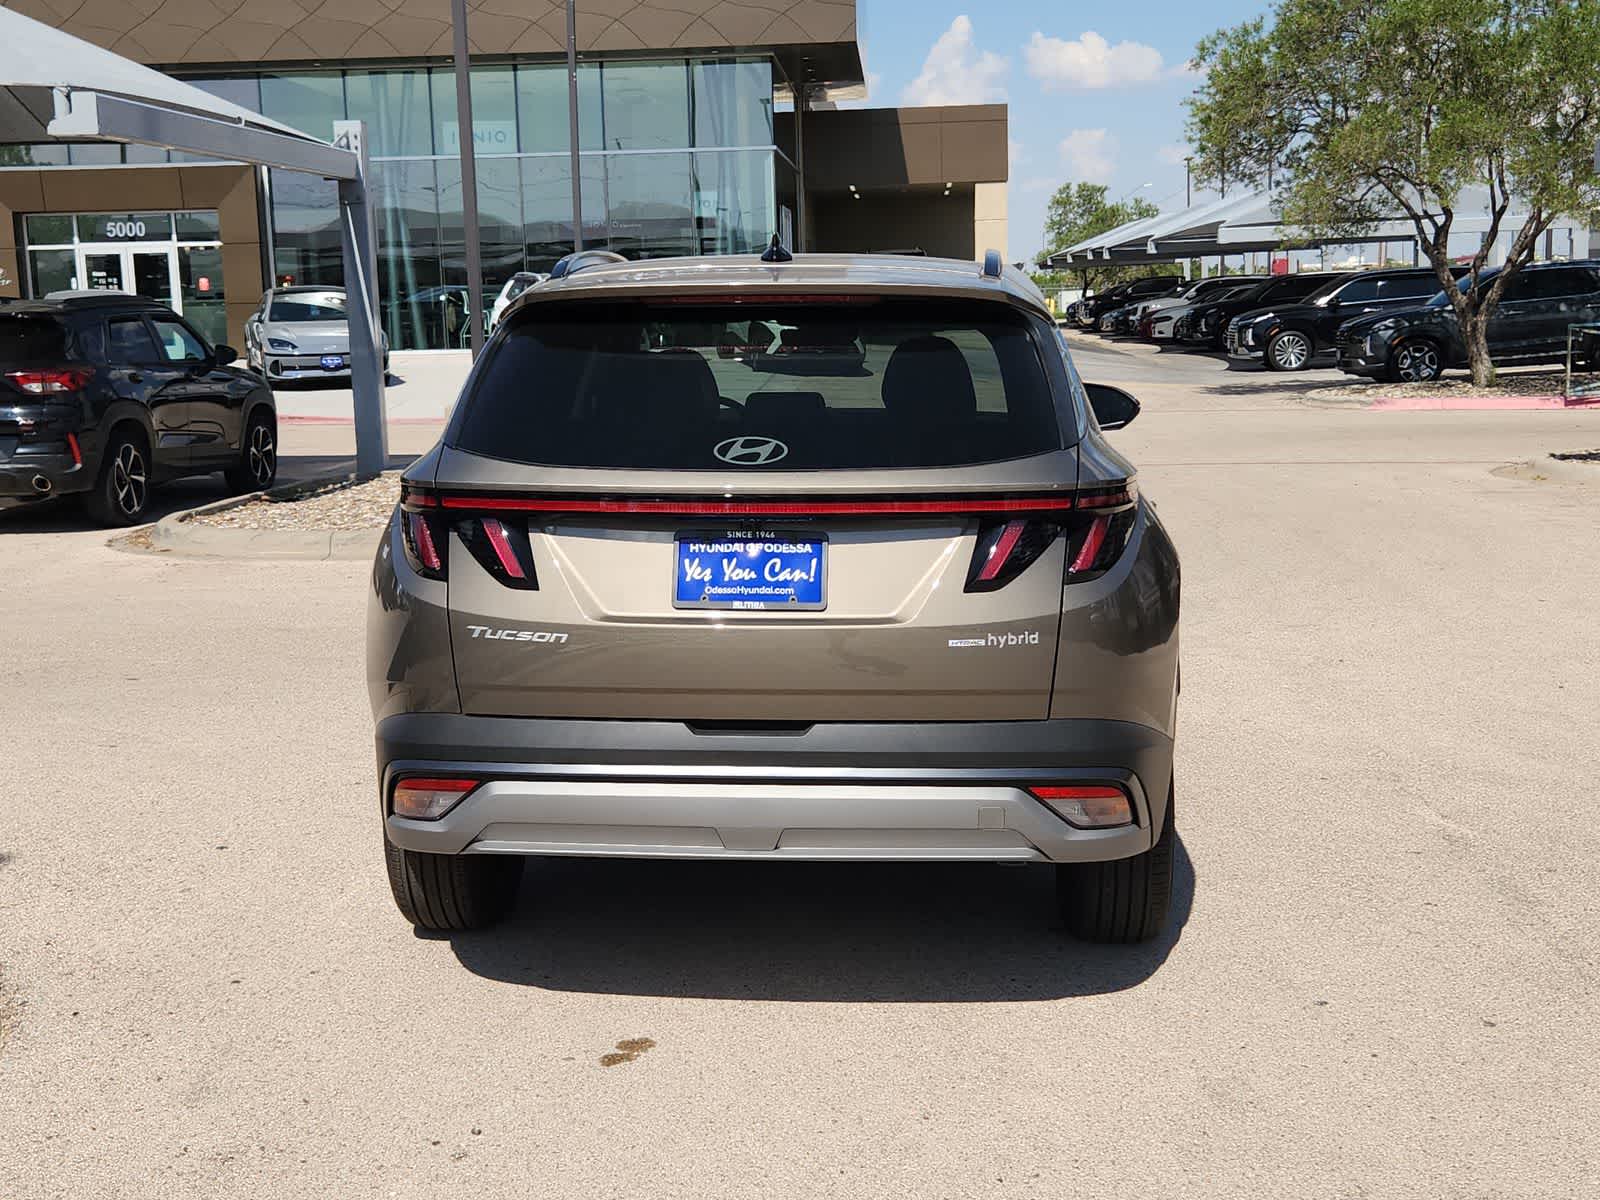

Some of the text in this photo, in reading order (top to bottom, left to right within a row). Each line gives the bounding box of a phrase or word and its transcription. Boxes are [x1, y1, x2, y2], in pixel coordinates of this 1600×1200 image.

[452, 129, 506, 144] INIQ
[106, 222, 146, 237] 5000
[727, 531, 776, 539] SINCE 1946
[690, 543, 744, 553] HYUNDAI
[764, 543, 812, 553] ODESSA
[684, 557, 818, 582] Yes You Can!
[704, 585, 795, 596] OdessaHyundai.com
[987, 631, 1039, 648] hybrid
